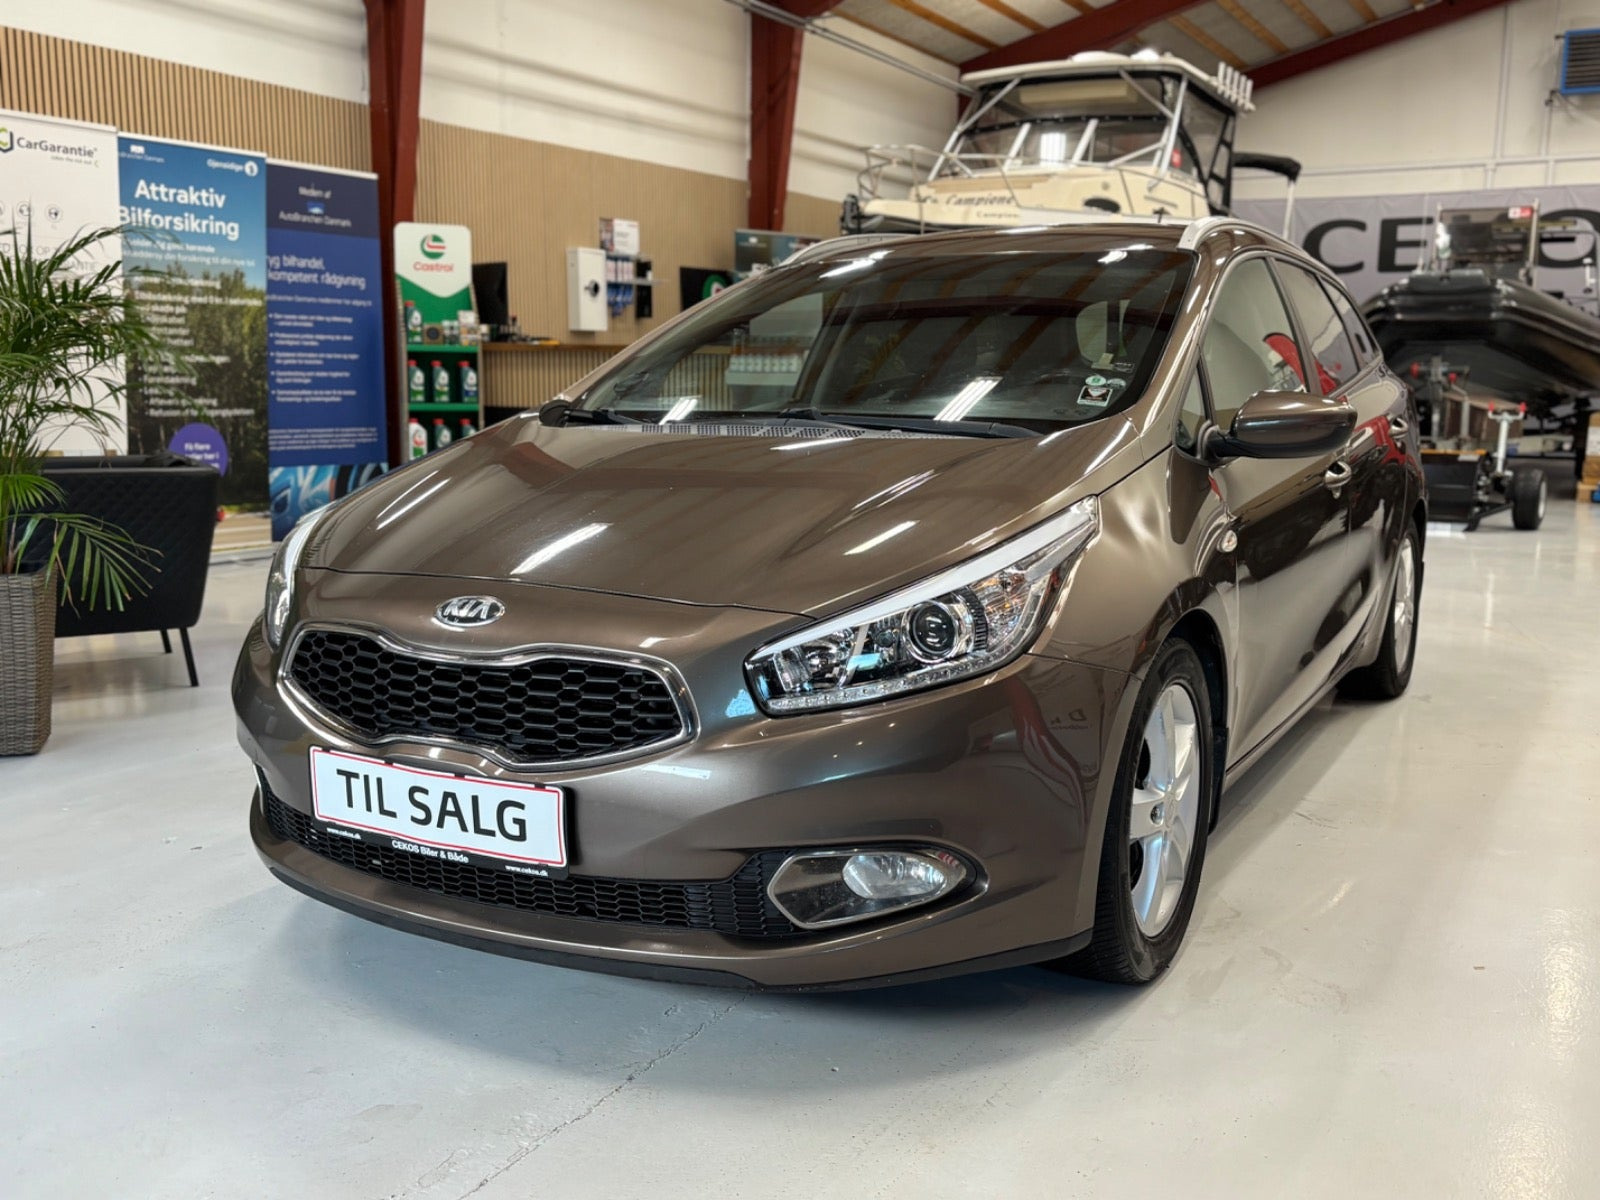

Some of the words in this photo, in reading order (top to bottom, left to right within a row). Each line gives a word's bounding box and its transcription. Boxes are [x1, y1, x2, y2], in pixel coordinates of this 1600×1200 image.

[16, 137, 95, 158] CarGarantie
[134, 179, 226, 208] Attraktiv
[118, 205, 240, 241] Bilforsikring
[412, 261, 454, 272] Castrol
[336, 767, 398, 820] TIL
[407, 784, 528, 843] SALG
[391, 839, 419, 854] CEKOS
[420, 846, 438, 857] Biler
[439, 850, 447, 859] &
[447, 850, 469, 864] Både
